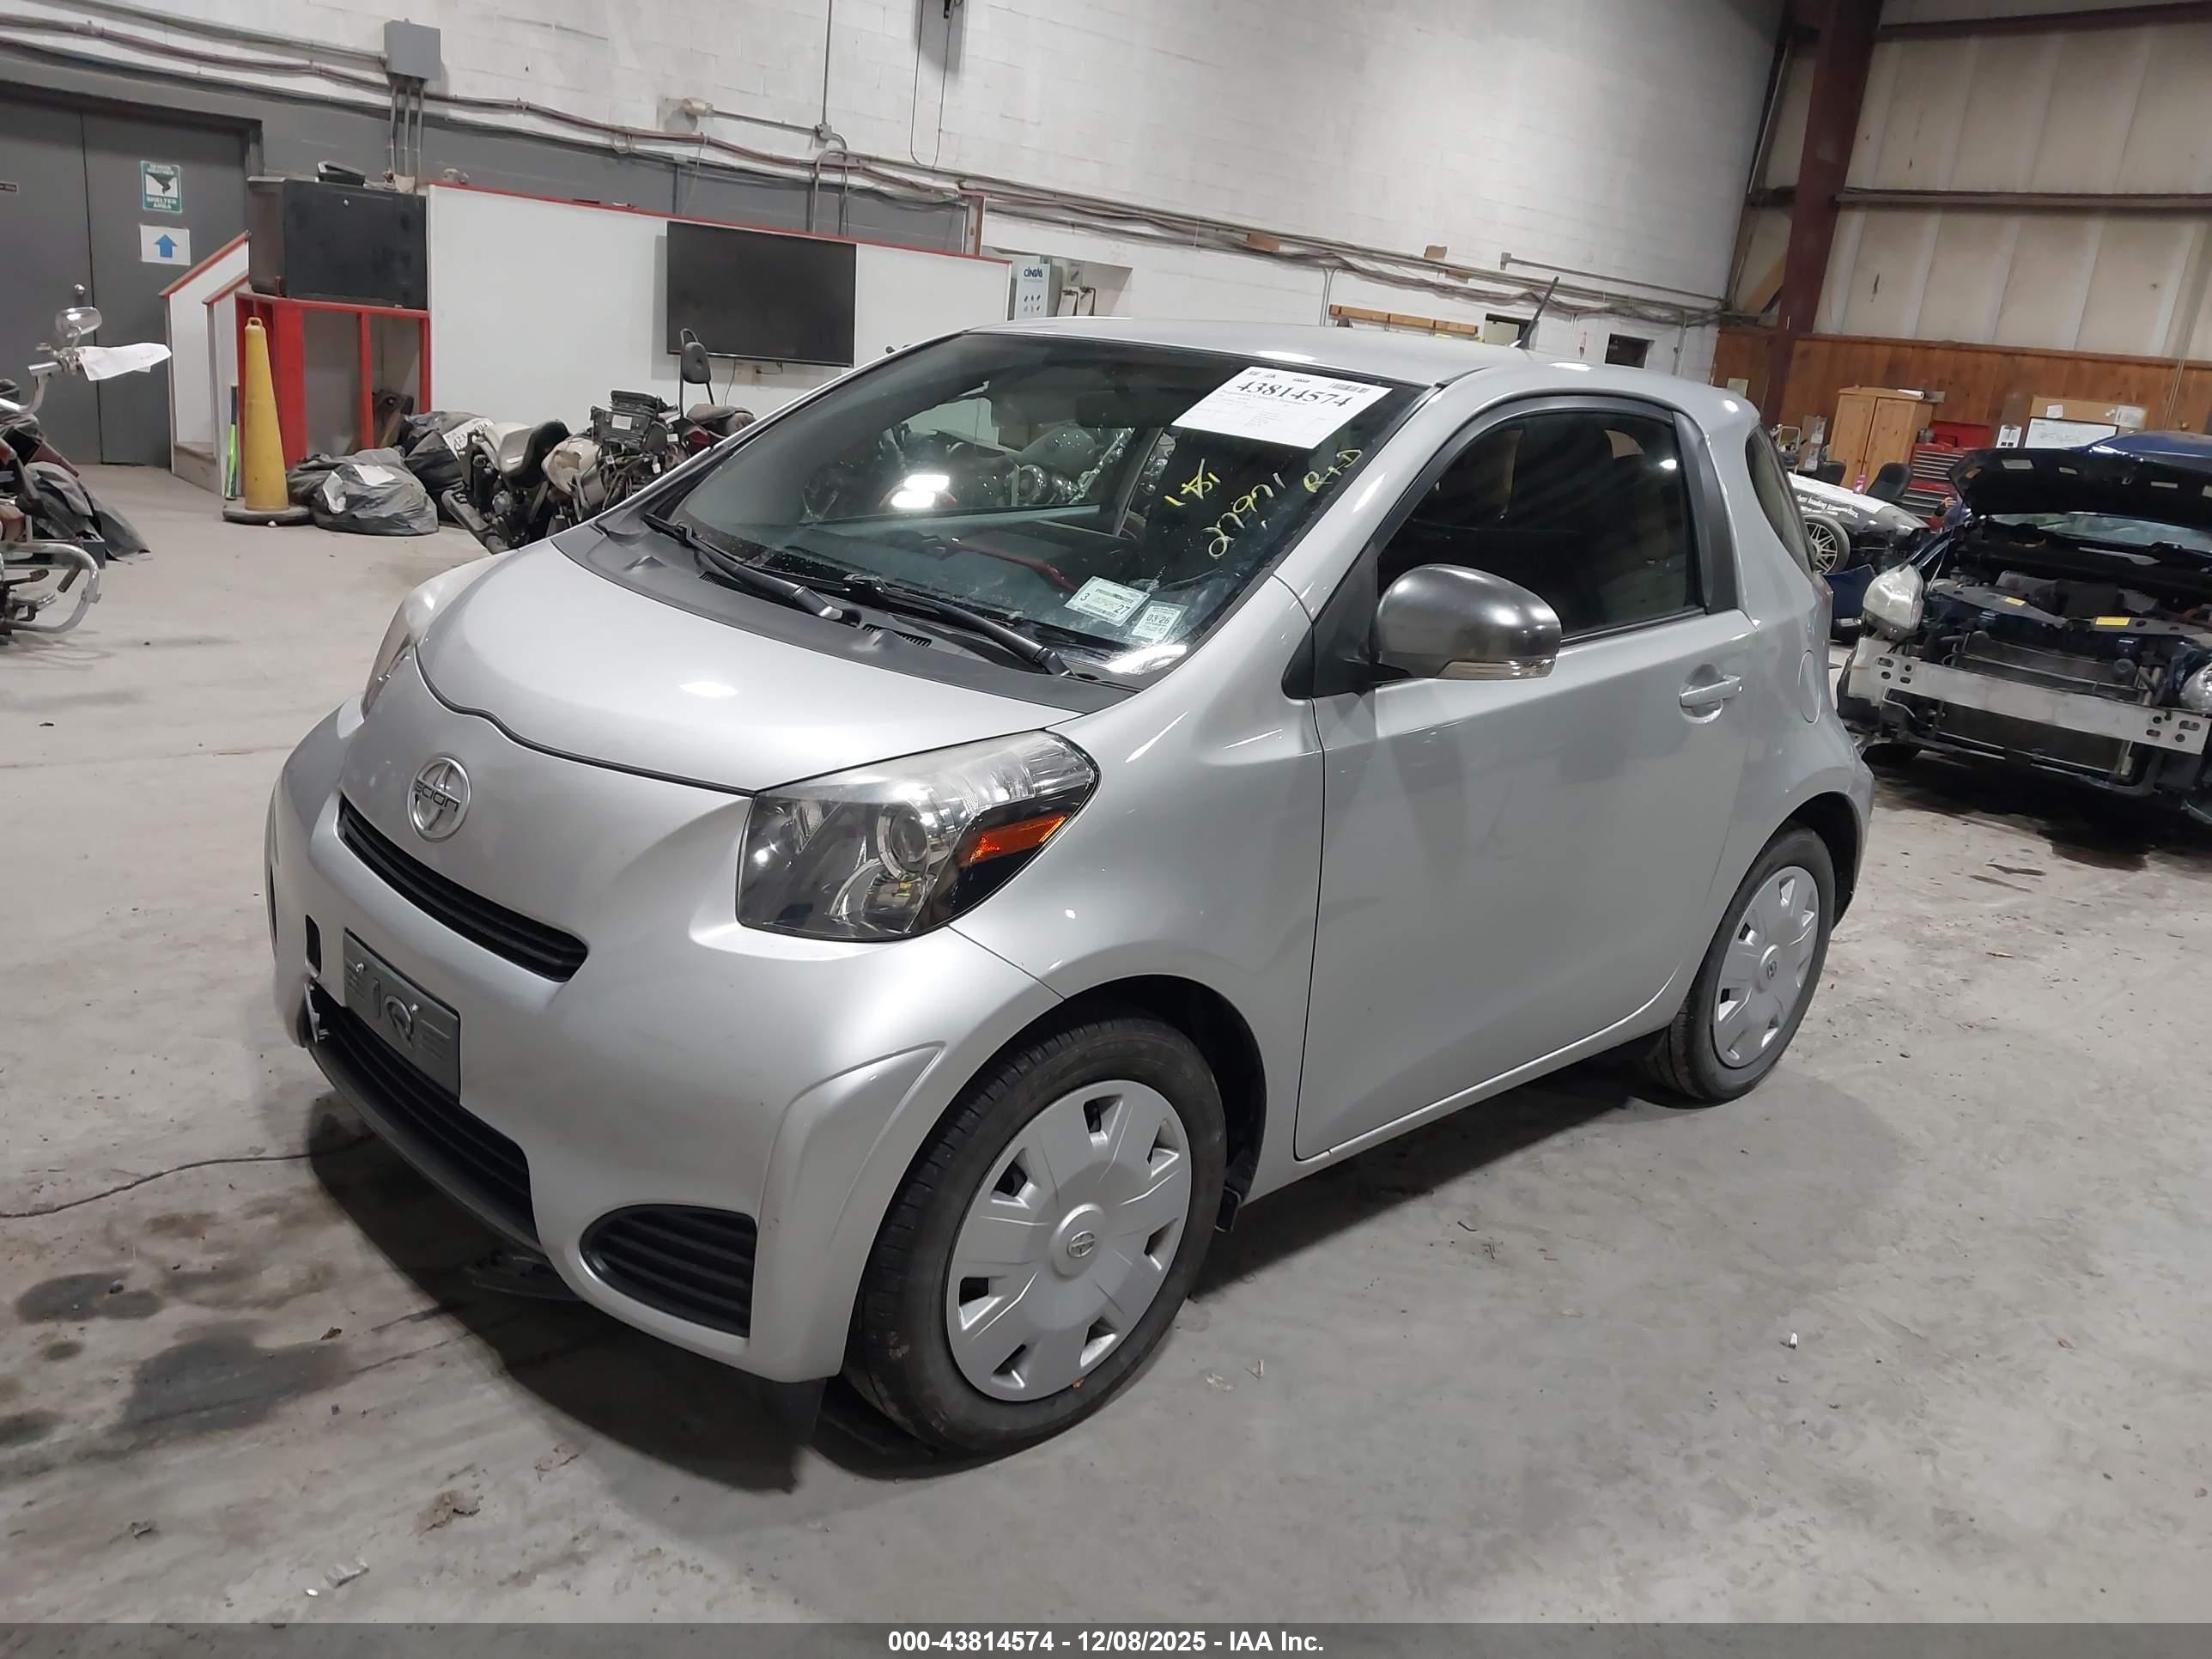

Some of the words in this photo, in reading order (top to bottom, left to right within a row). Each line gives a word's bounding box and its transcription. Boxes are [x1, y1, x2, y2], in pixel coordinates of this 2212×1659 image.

[1237, 381, 1353, 407] 43814574
[1080, 592, 1091, 601] 3
[1114, 604, 1131, 615] 27
[413, 778, 459, 813] SCION
